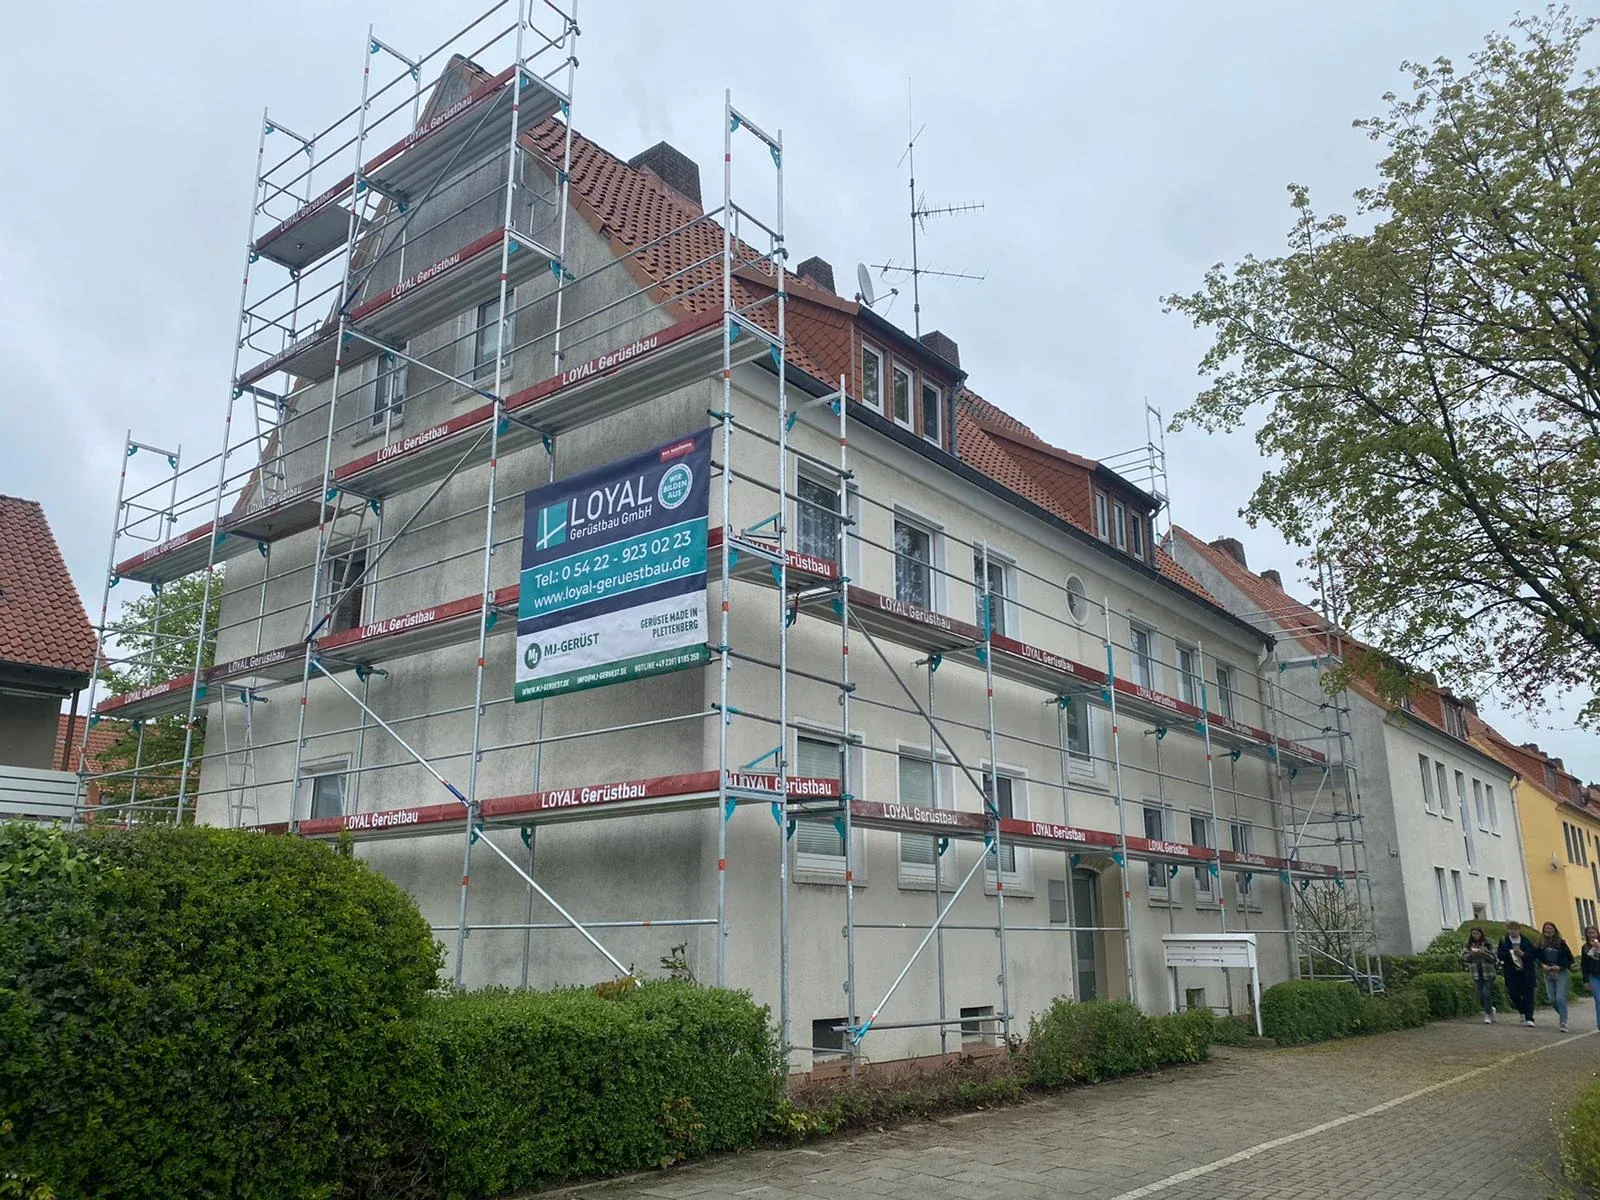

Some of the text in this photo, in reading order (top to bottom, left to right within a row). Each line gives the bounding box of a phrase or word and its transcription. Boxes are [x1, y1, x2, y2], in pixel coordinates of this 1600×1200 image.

[404, 95, 472, 146] LOYAL Gerüstbau
[390, 253, 460, 298] LOYAL Gerüstbau
[562, 336, 658, 386] LOYAL Gerüstbau
[376, 425, 448, 463] LOYAL Gerüstbau
[663, 479, 688, 493] BILDEN
[667, 489, 682, 499] AUS
[570, 476, 653, 527] LOYAL
[570, 504, 653, 541] Gerüstbau GmbH
[535, 571, 559, 588] Tel.:
[562, 566, 571, 580] 0
[574, 560, 590, 577] 54
[594, 554, 610, 572] 22
[622, 543, 647, 563] 923
[651, 537, 669, 555] 02
[673, 530, 692, 549] 23
[534, 555, 690, 609] www.loyal-geruestbau.de
[640, 607, 698, 629] GERÜSTE MADE IN
[879, 597, 908, 616] LOYAL
[361, 610, 435, 639] LOYAL Gerüstbau
[652, 620, 699, 638] PLETTENBERG
[544, 633, 600, 657] MJ-GERÜST
[541, 782, 646, 808] LOYAL Gerüstbau
[343, 811, 419, 830] LOYAL Gerüstbau
[883, 803, 958, 825] LOYAL Gerüstbau
[1031, 822, 1086, 842] LOYAL Gerüstbau
